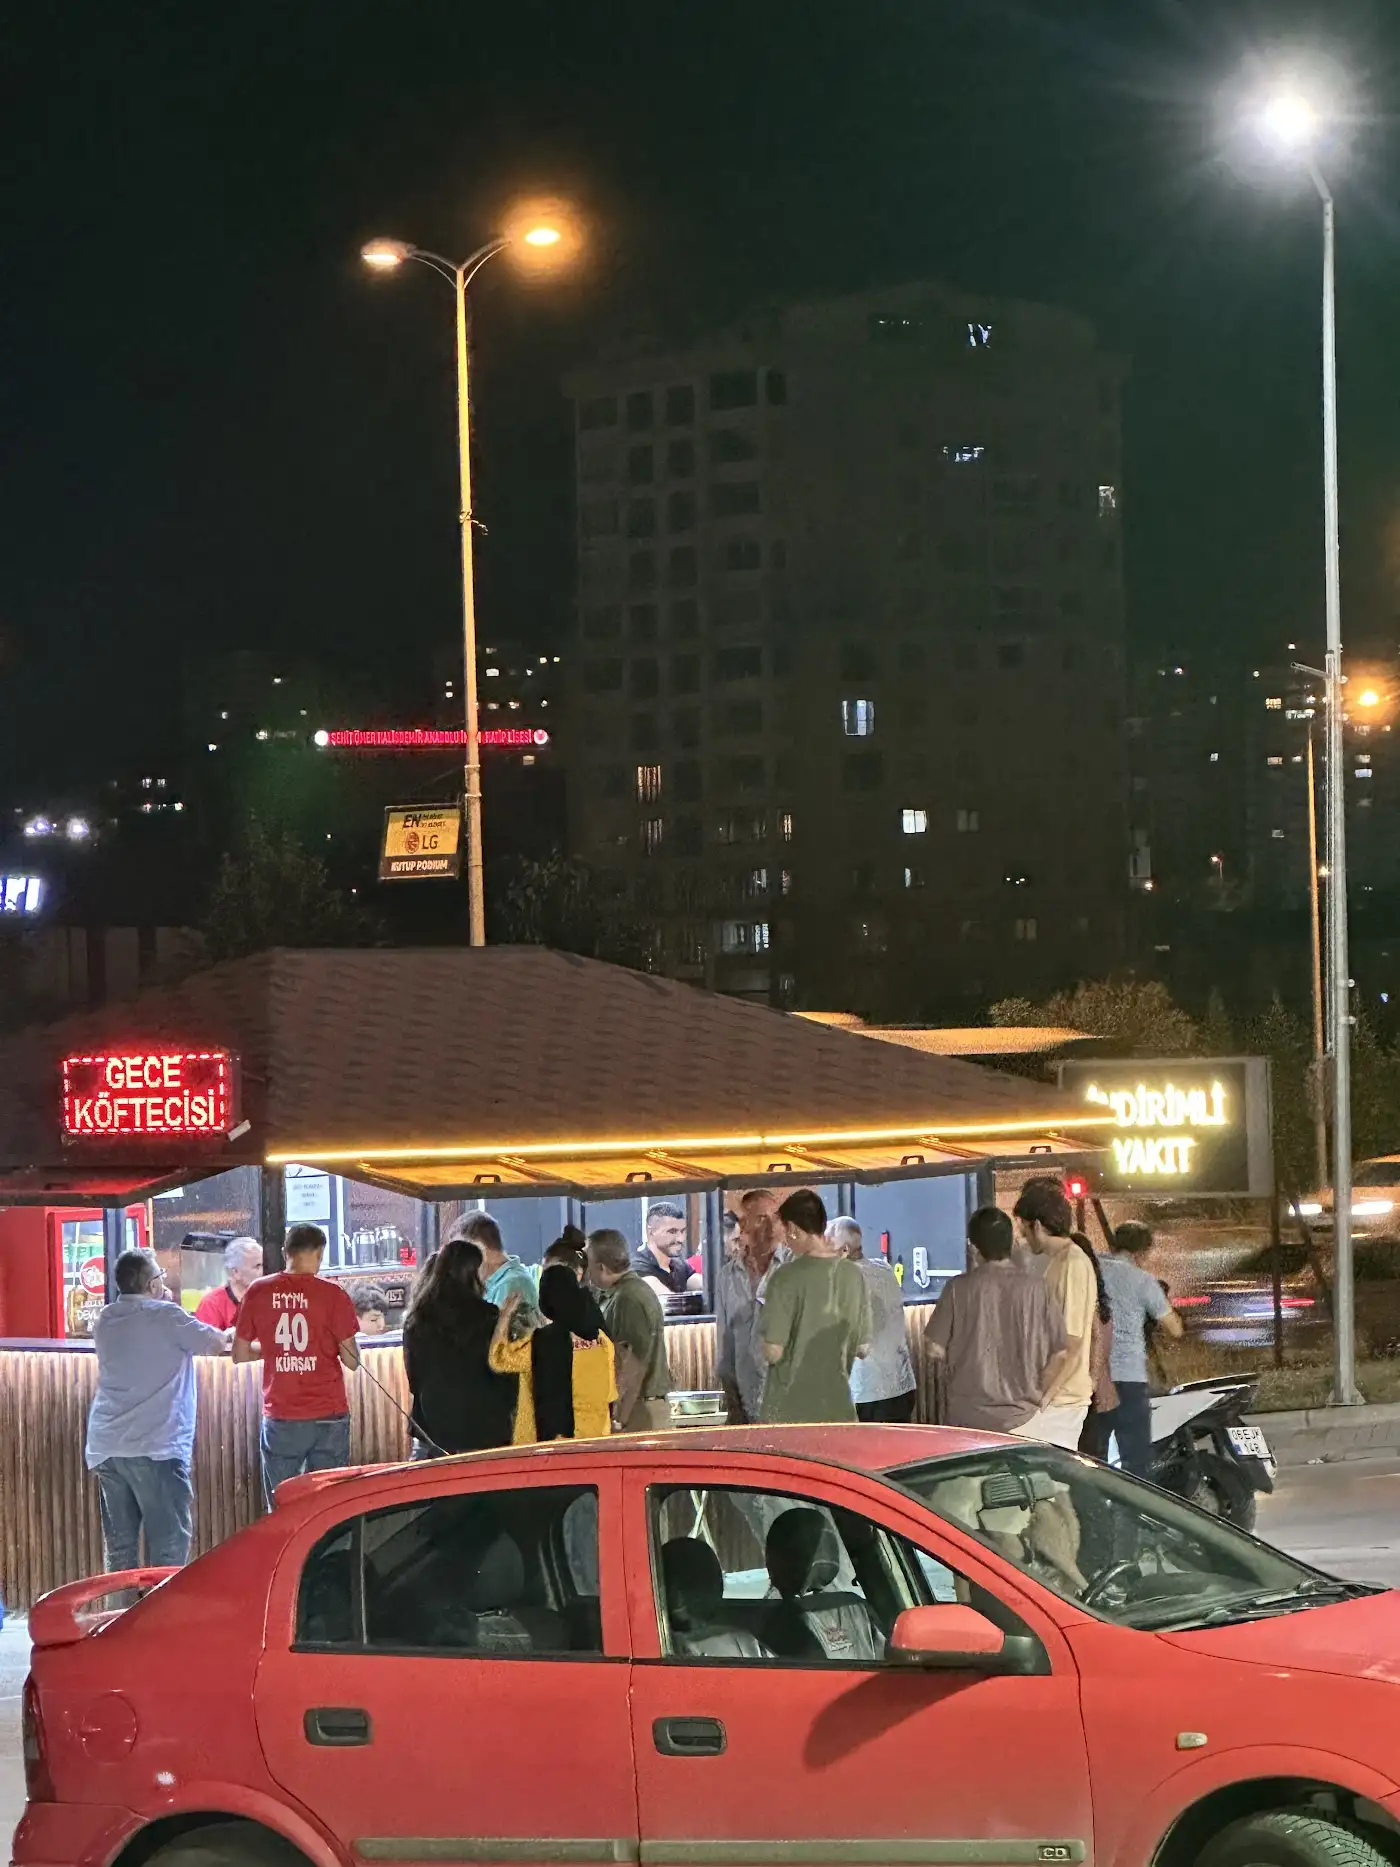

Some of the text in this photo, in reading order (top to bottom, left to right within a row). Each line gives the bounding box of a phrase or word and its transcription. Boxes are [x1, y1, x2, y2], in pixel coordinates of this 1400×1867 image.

[422, 834, 439, 850] LG
[105, 1055, 183, 1089] GECE
[74, 1089, 215, 1128] KÖFTECİSİ
[275, 1312, 309, 1352] 40
[275, 1352, 318, 1376] KÜRŞAT
[1042, 1847, 1067, 1857] CD
